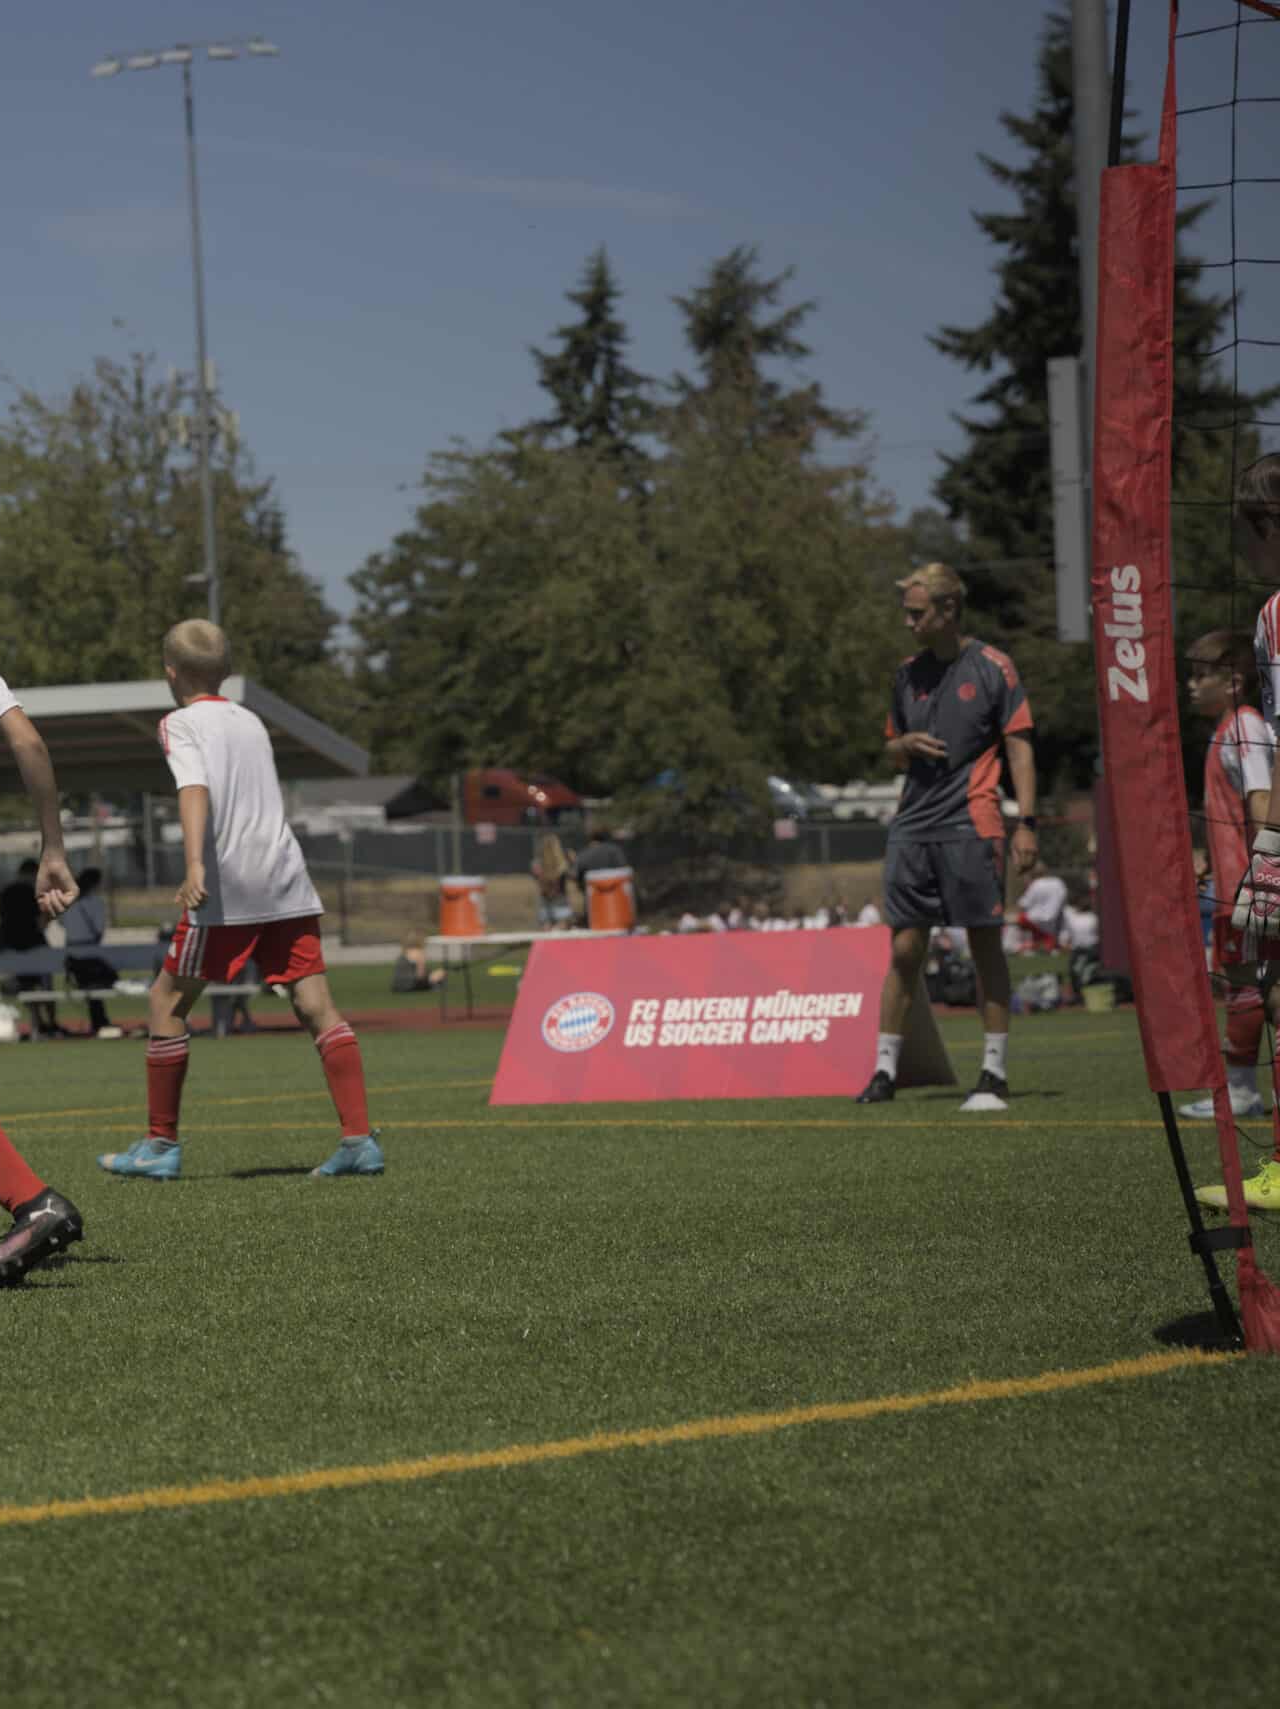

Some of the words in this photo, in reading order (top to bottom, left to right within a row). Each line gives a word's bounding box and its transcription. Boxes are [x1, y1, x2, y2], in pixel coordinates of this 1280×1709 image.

[1104, 564, 1150, 703] Zelus
[629, 999, 660, 1023] FC
[661, 997, 750, 1022] BAYERN
[752, 989, 864, 1020] MÜNCHEN
[624, 1023, 656, 1047] US
[657, 1021, 746, 1046] SOCCER
[750, 1019, 830, 1045] CAMPS
